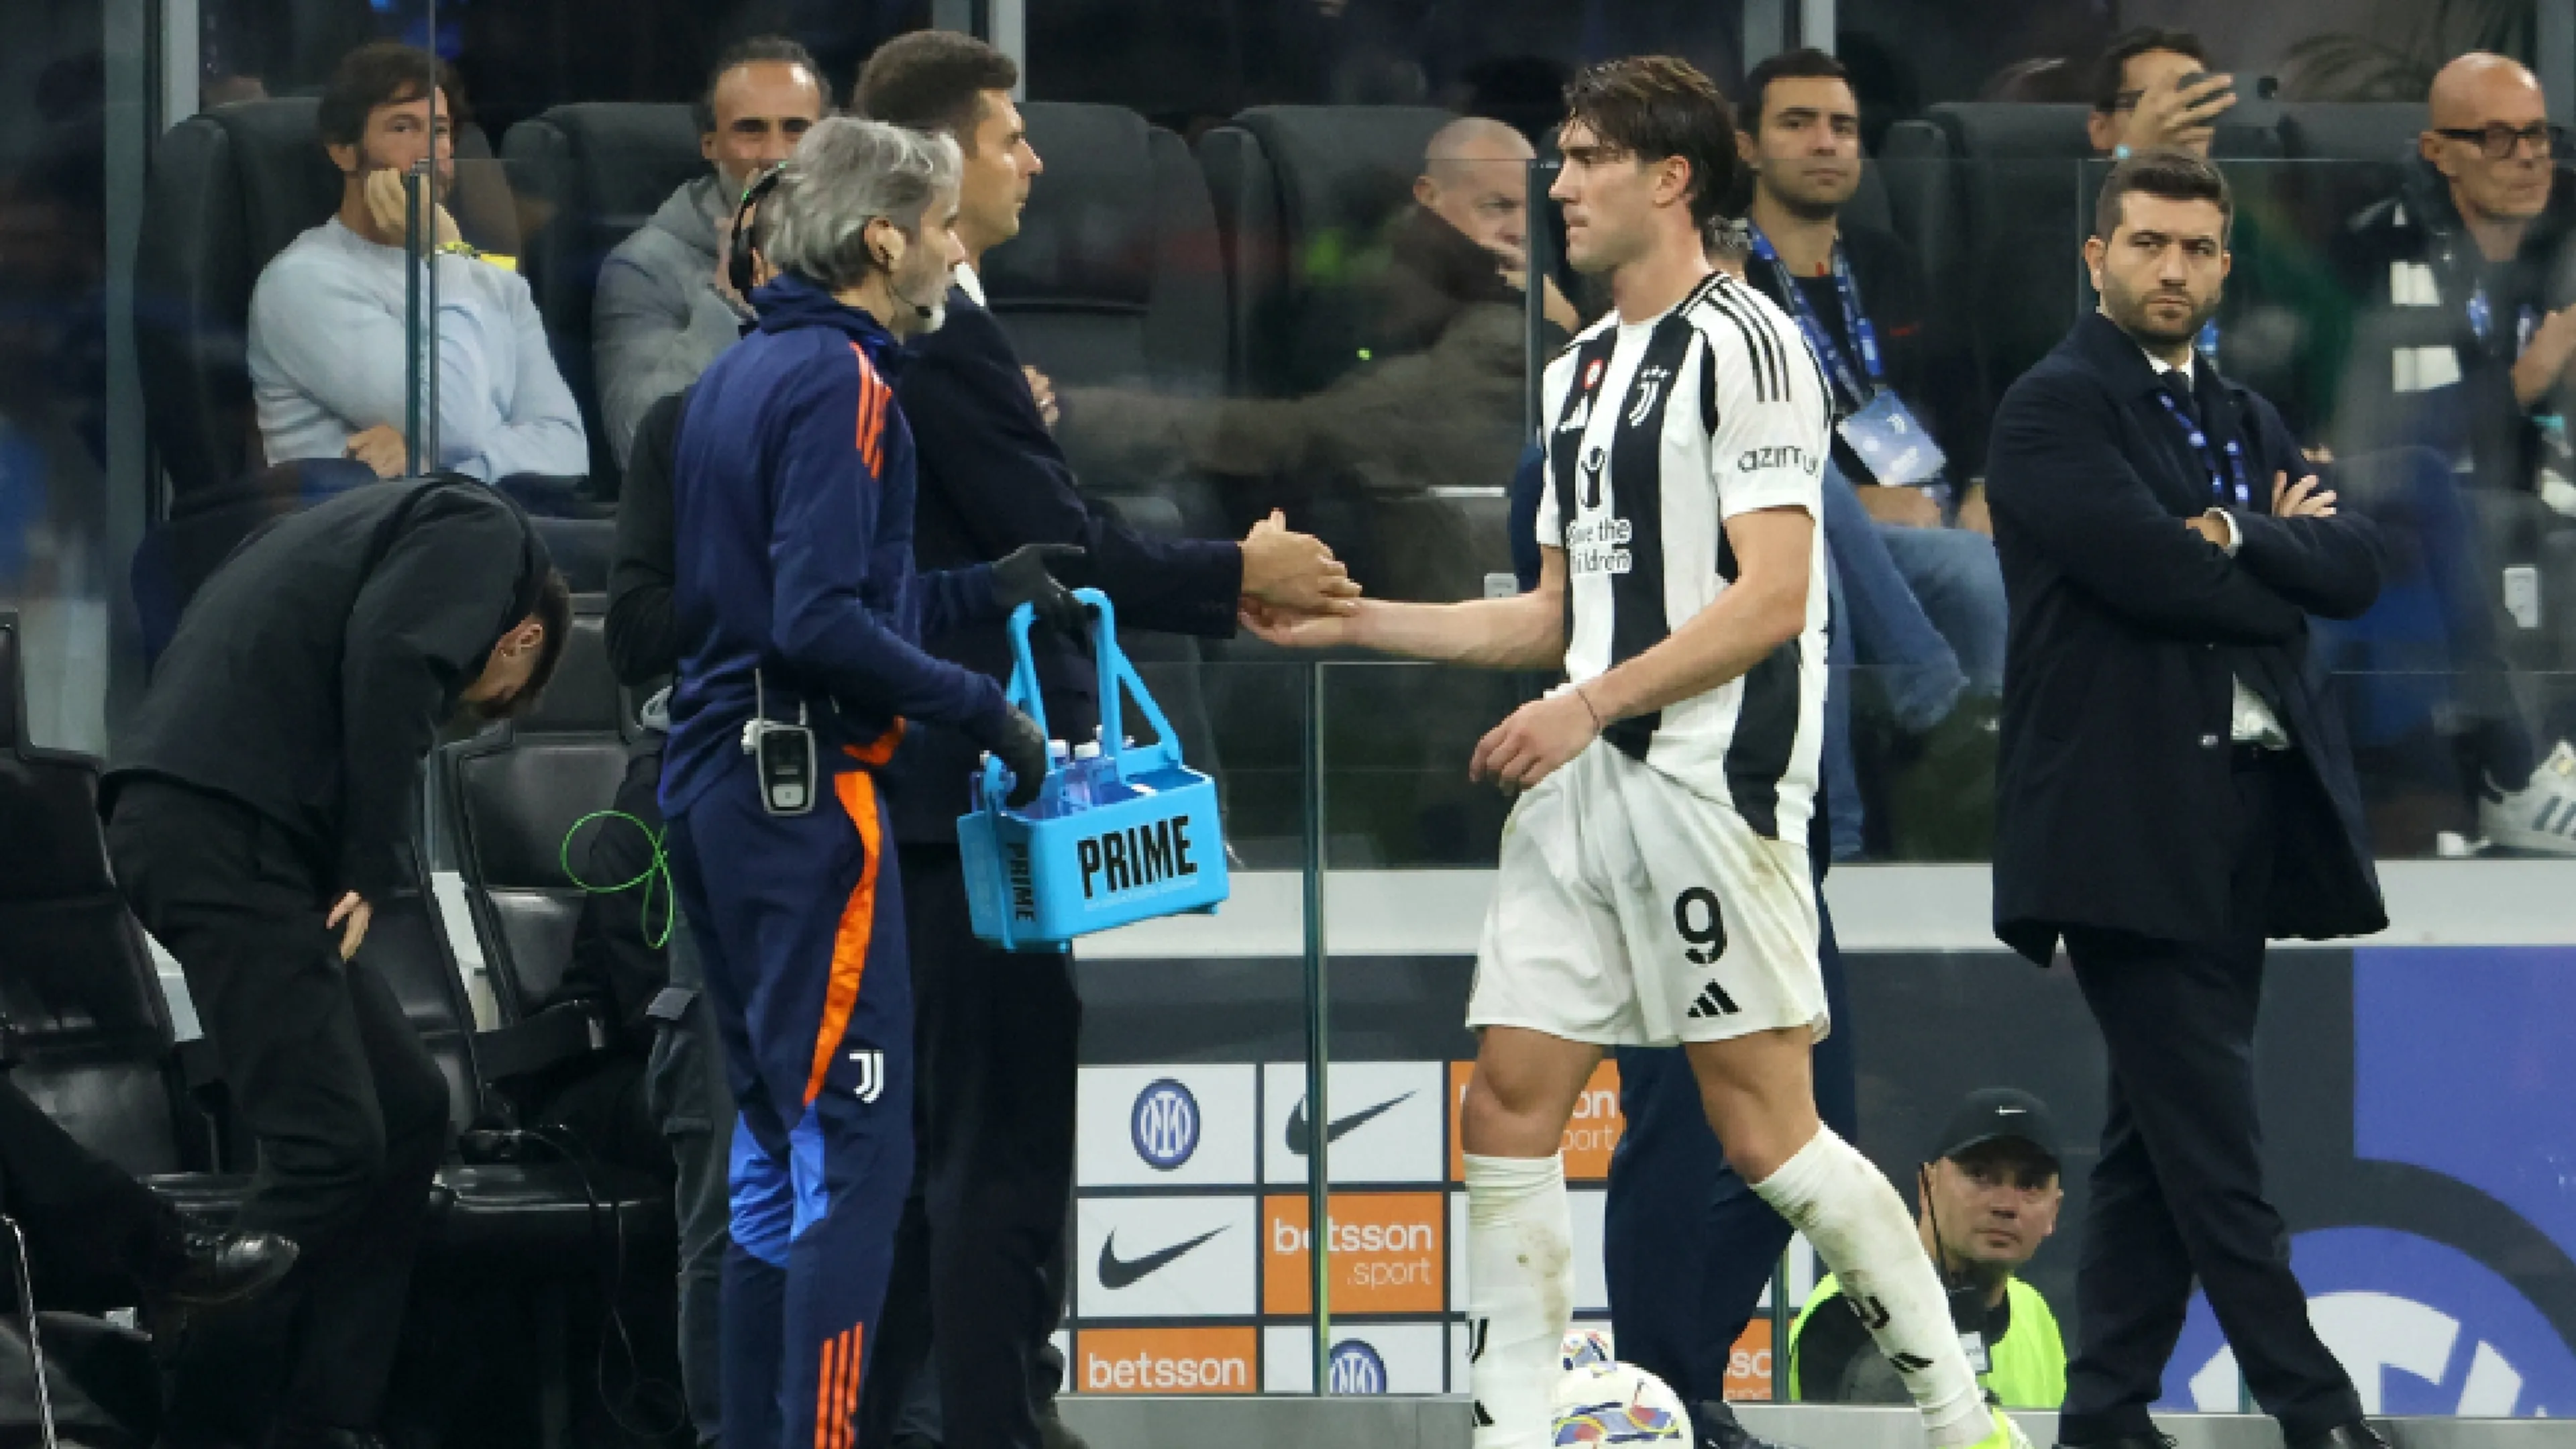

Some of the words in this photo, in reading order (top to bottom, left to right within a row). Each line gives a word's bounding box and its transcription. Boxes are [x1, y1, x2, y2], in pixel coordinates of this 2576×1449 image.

[1737, 445, 1819, 476] azimu
[1598, 515, 1631, 541] the
[1077, 814, 1198, 899] PRIME
[1006, 843, 1035, 922] PRIME
[1674, 887, 1727, 965] 9
[1346, 1256, 1432, 1290] .sport
[1088, 1350, 1246, 1389] betsson
